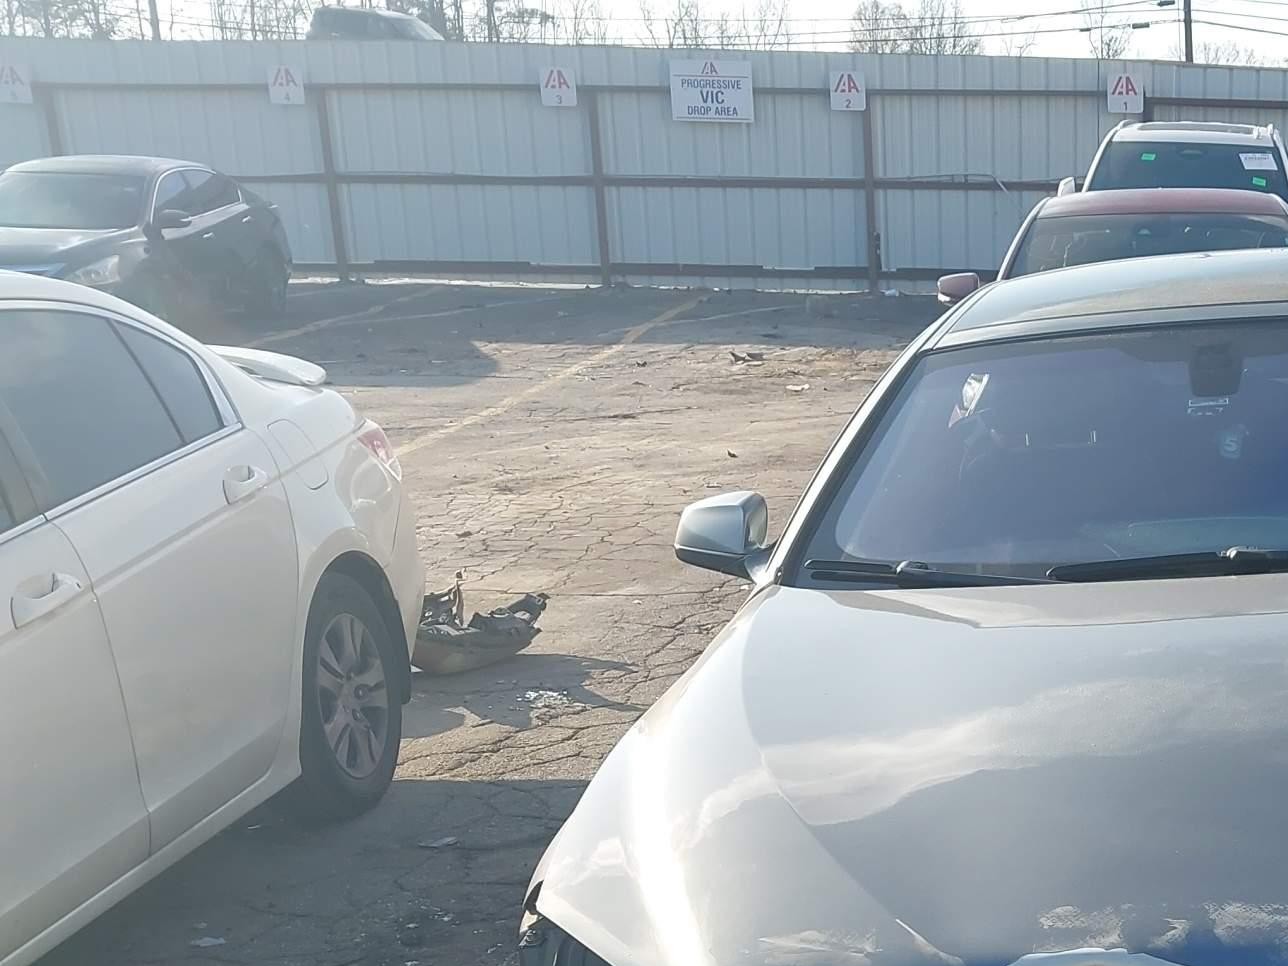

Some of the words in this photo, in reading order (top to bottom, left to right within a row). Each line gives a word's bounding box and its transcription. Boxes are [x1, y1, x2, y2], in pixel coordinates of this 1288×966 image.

[680, 78, 743, 90] PROGRESSIVE
[554, 94, 563, 105] 3
[699, 90, 726, 105] VIC
[845, 98, 852, 109] 2
[687, 105, 712, 116] DROP
[714, 106, 739, 117] AREA
